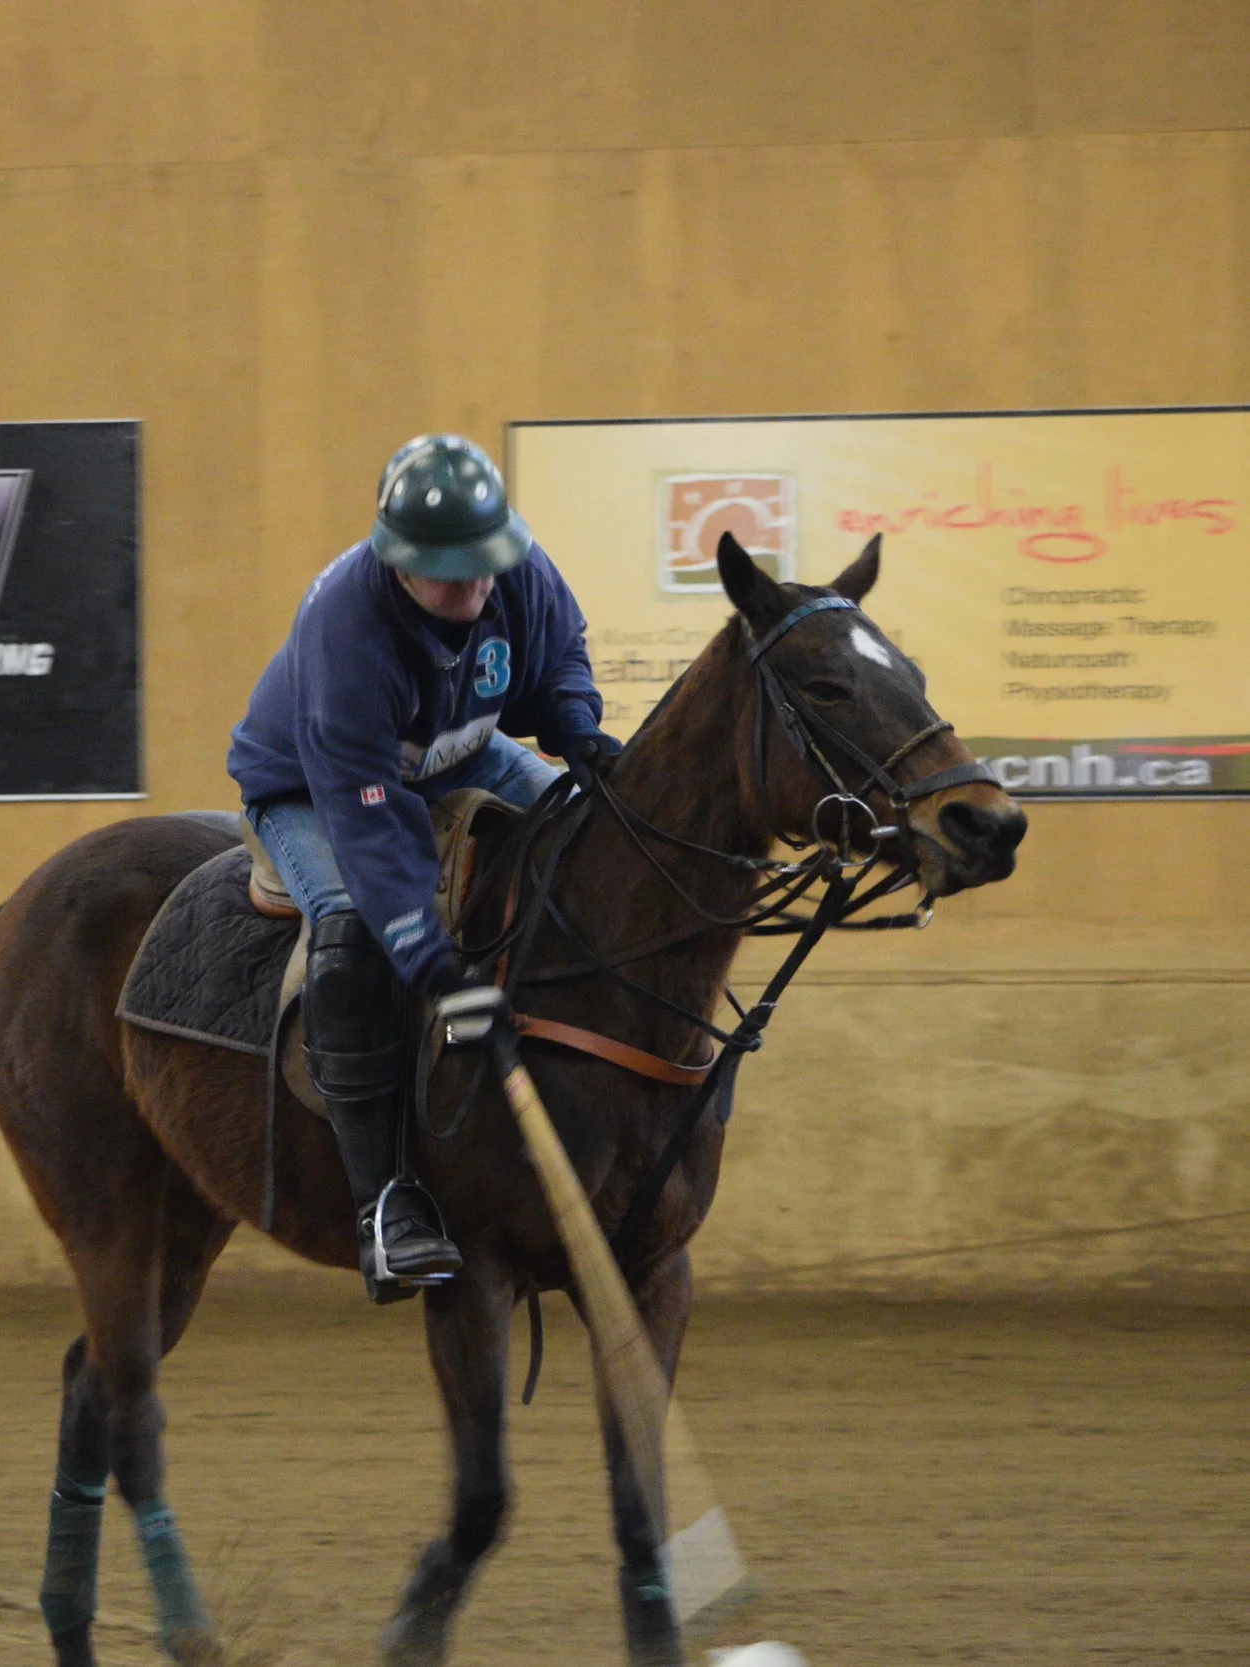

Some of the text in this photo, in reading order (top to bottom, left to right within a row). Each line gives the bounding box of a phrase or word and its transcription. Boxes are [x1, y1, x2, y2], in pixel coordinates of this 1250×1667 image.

[834, 461, 1237, 563] enriching lives
[1004, 586, 1147, 608] Chiropractic
[1000, 615, 1220, 641] Massage Therapy
[474, 637, 512, 698] 3
